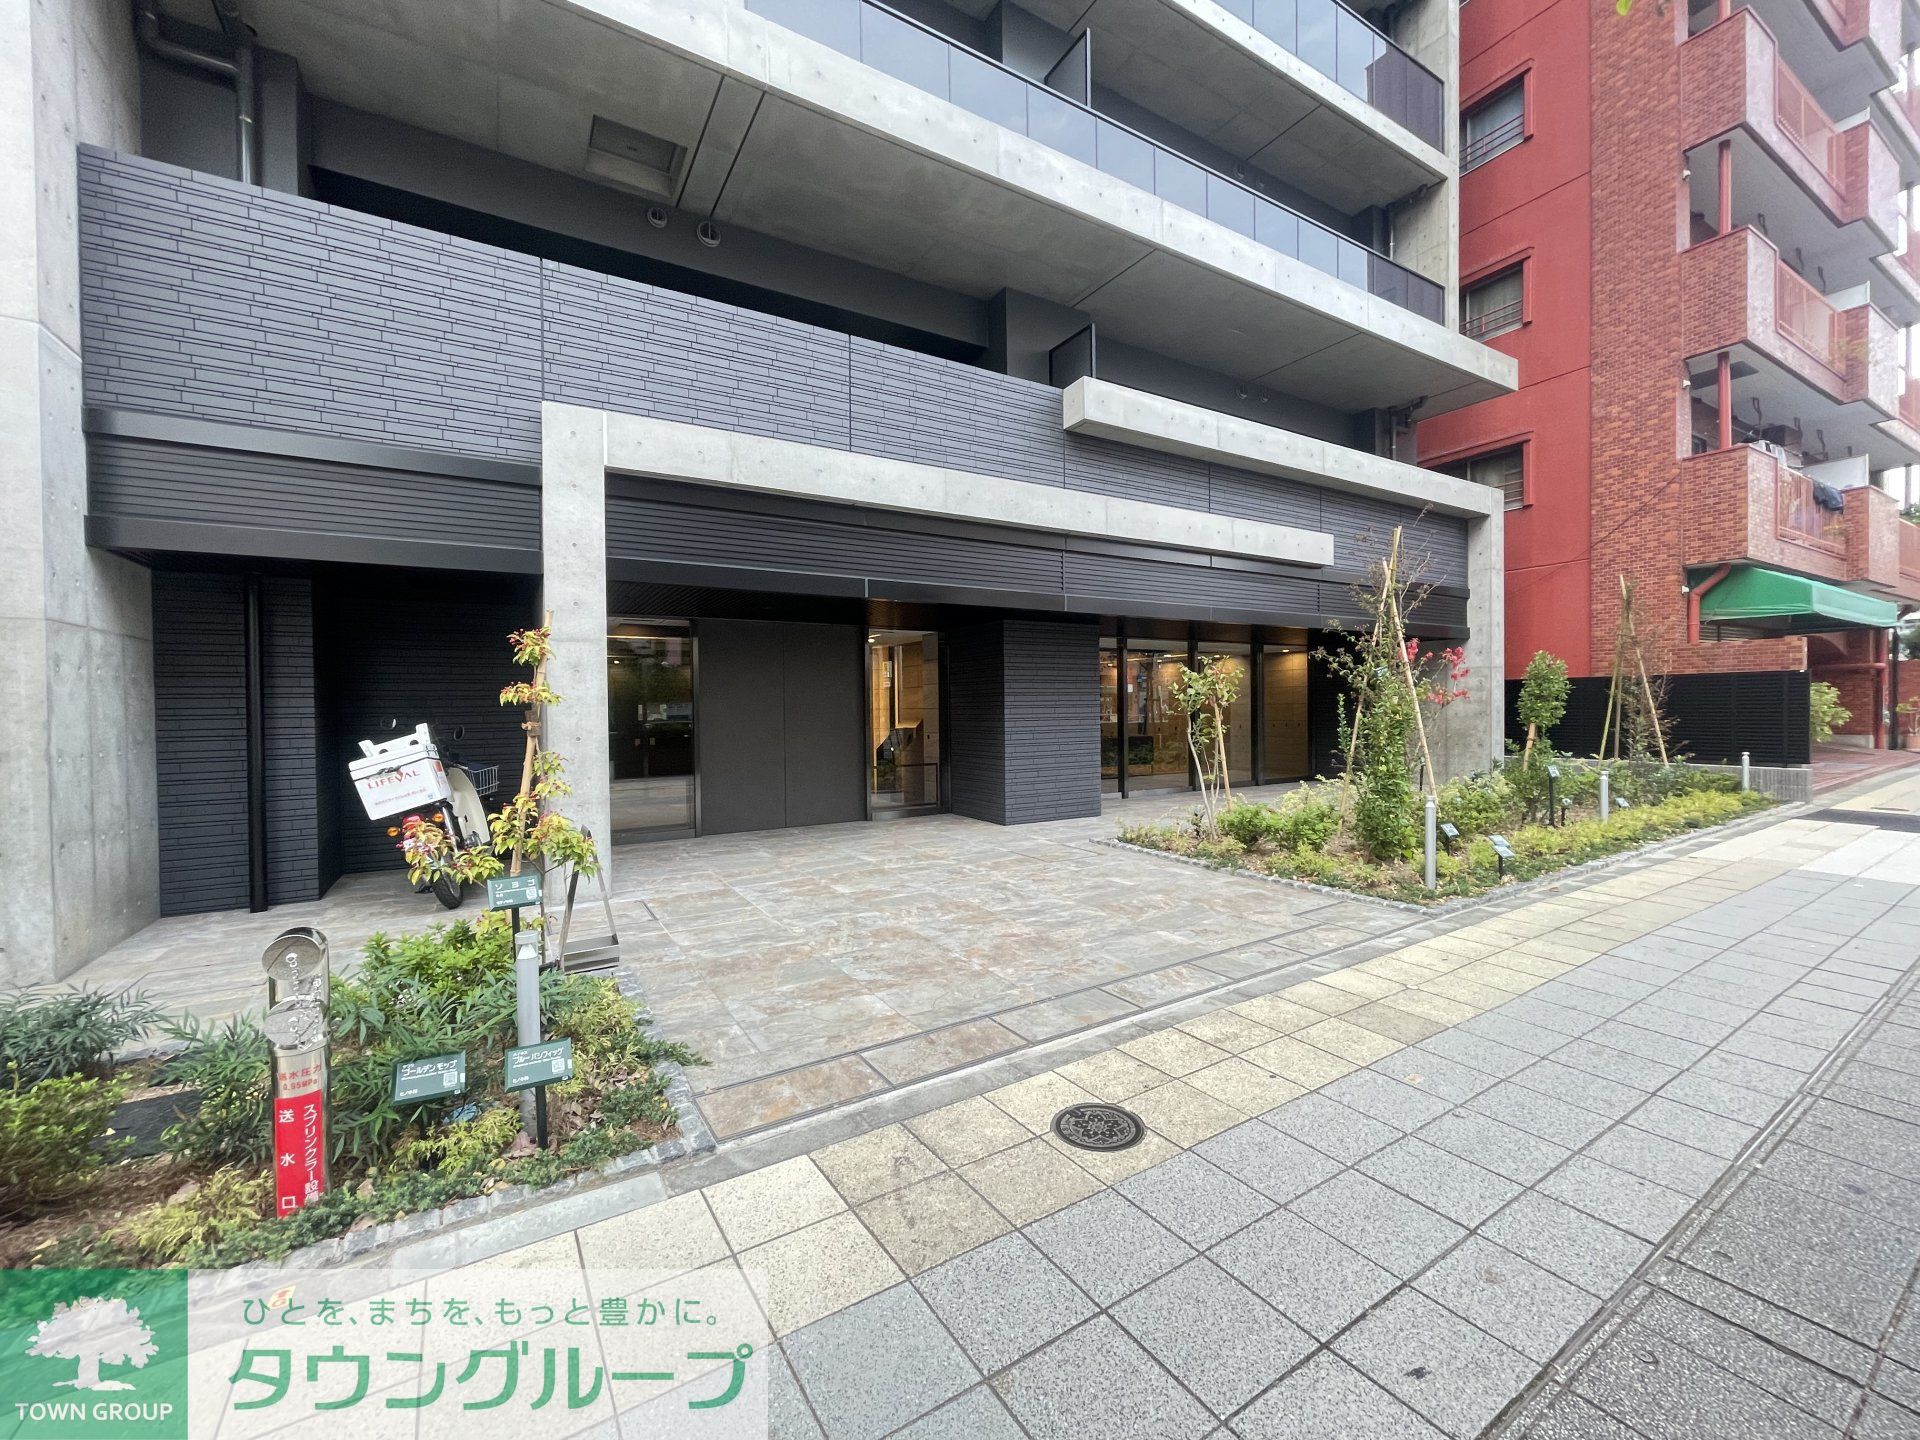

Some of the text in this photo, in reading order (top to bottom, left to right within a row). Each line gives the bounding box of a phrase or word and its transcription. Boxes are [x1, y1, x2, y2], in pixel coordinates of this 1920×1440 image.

[367, 768, 420, 790] LIFEVAL
[279, 1108, 296, 1209] 送水口
